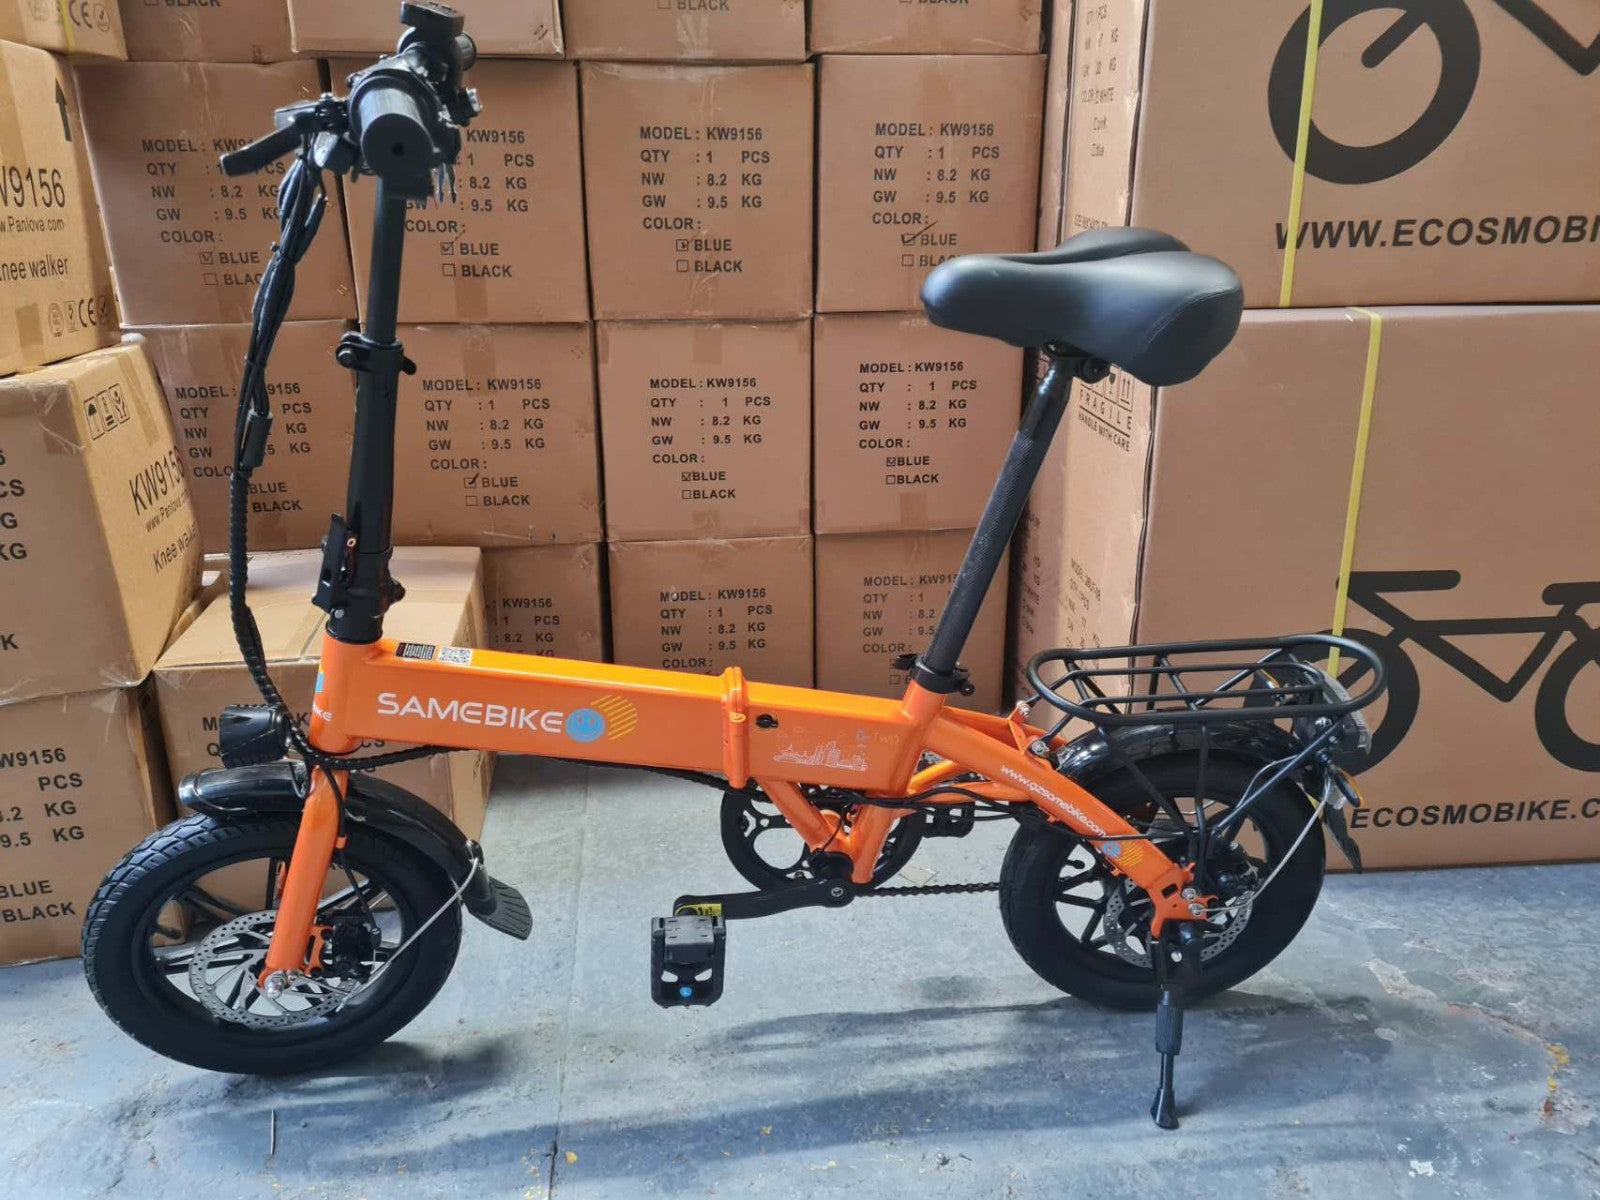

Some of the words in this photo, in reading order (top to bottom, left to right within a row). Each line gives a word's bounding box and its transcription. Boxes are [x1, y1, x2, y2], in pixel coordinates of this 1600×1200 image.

[466, 129, 525, 143] KW9156
[706, 127, 763, 141] KW9156
[940, 123, 994, 136] KW9156
[640, 150, 670, 163] QTY
[741, 151, 771, 164] PCS
[875, 145, 904, 159] QTY
[972, 146, 1000, 159] PCS
[504, 153, 535, 167] PCS
[147, 162, 176, 176] QTY
[873, 168, 897, 181] NW
[937, 169, 957, 181] 8.2
[970, 168, 991, 181] KG
[469, 176, 491, 190] 8.2
[505, 176, 527, 190] KG
[641, 172, 665, 185] NW
[707, 173, 728, 186] 8.2
[741, 173, 762, 186] KG
[151, 185, 175, 198] NW
[220, 184, 243, 198] 8.2
[872, 191, 897, 203] GW
[936, 191, 956, 204] 9.5
[969, 191, 989, 203] KG
[470, 199, 493, 212] 9.5
[506, 200, 528, 212] KG
[642, 194, 666, 208] GW
[707, 196, 728, 209] 9.5
[741, 195, 762, 208] KG
[156, 208, 180, 220] GW
[224, 208, 247, 221] 9.5
[694, 239, 733, 251] BLUE
[920, 233, 957, 246] BLUE
[460, 242, 500, 256] BLUE
[219, 251, 260, 264] BLUE
[919, 254, 957, 267] BLA
[0, 261, 27, 281] nee
[28, 253, 69, 278] walker
[461, 264, 513, 278] BLACK
[694, 260, 743, 273] BLACK
[224, 273, 262, 286] BLAC
[914, 361, 964, 372] KW9156
[268, 382, 301, 395] 9156
[487, 378, 542, 390] KW9156
[706, 378, 757, 388] KW9156
[859, 382, 885, 393] QTY
[951, 380, 977, 390] PCS
[424, 400, 453, 412] QTY
[522, 398, 551, 410] PCS
[651, 397, 677, 408] QTY
[745, 396, 771, 406] PCS
[859, 401, 880, 412] NW
[918, 400, 936, 411] 8.2
[948, 399, 967, 410] KG
[180, 407, 209, 420] QTY
[282, 402, 312, 415] PCS
[426, 420, 449, 431] NW
[489, 419, 510, 431] 8.2
[523, 418, 544, 430] KG
[651, 416, 672, 427] NW
[712, 416, 730, 426] 8.2
[743, 415, 761, 426] KG
[859, 420, 880, 431] GW
[918, 419, 936, 429] 9.5
[948, 418, 967, 428] KG
[184, 427, 208, 439] NW
[286, 423, 307, 434] KG
[428, 440, 451, 451] GW
[491, 439, 512, 450] 9.5
[525, 438, 545, 449] KG
[651, 435, 674, 445] GW
[713, 435, 731, 445] 9.5
[743, 434, 762, 444] KG
[189, 447, 212, 459] GW
[289, 443, 311, 454] KG
[897, 456, 930, 466] BLUE
[193, 466, 234, 478] COLO
[692, 471, 726, 481] BLUE
[481, 476, 519, 488] BLUE
[896, 474, 939, 485] BLACK
[249, 482, 287, 494] BLUE
[693, 489, 736, 500] BLACK
[252, 500, 302, 513] BLACK
[483, 495, 530, 506] BLACK
[152, 543, 178, 574] Knee
[919, 574, 957, 585] KW91
[717, 588, 766, 600] KW9156
[863, 593, 888, 604] QTY
[502, 597, 552, 608] KW9156
[661, 609, 686, 619] QTY
[747, 605, 773, 615] PCS
[863, 610, 882, 620] NW
[918, 609, 935, 619] 8.2
[534, 615, 560, 625] PCS
[661, 626, 681, 636] NW
[718, 624, 736, 634] 8.2
[747, 622, 766, 632] KG
[862, 627, 883, 637] GW
[917, 626, 935, 636] 9.5
[503, 633, 522, 643] 8.2
[535, 632, 554, 642] KG
[662, 643, 683, 653] GW
[718, 640, 736, 650] 9.5
[747, 639, 766, 649] KG
[377, 691, 565, 734] SAMEBIKE
[0, 747, 67, 768] W9156
[38, 773, 83, 791] PCS
[44, 800, 77, 817] KG
[0, 832, 31, 848] 9.5
[53, 826, 85, 842] KG
[0, 880, 53, 899] BLUE
[3, 902, 76, 923] BLACK
